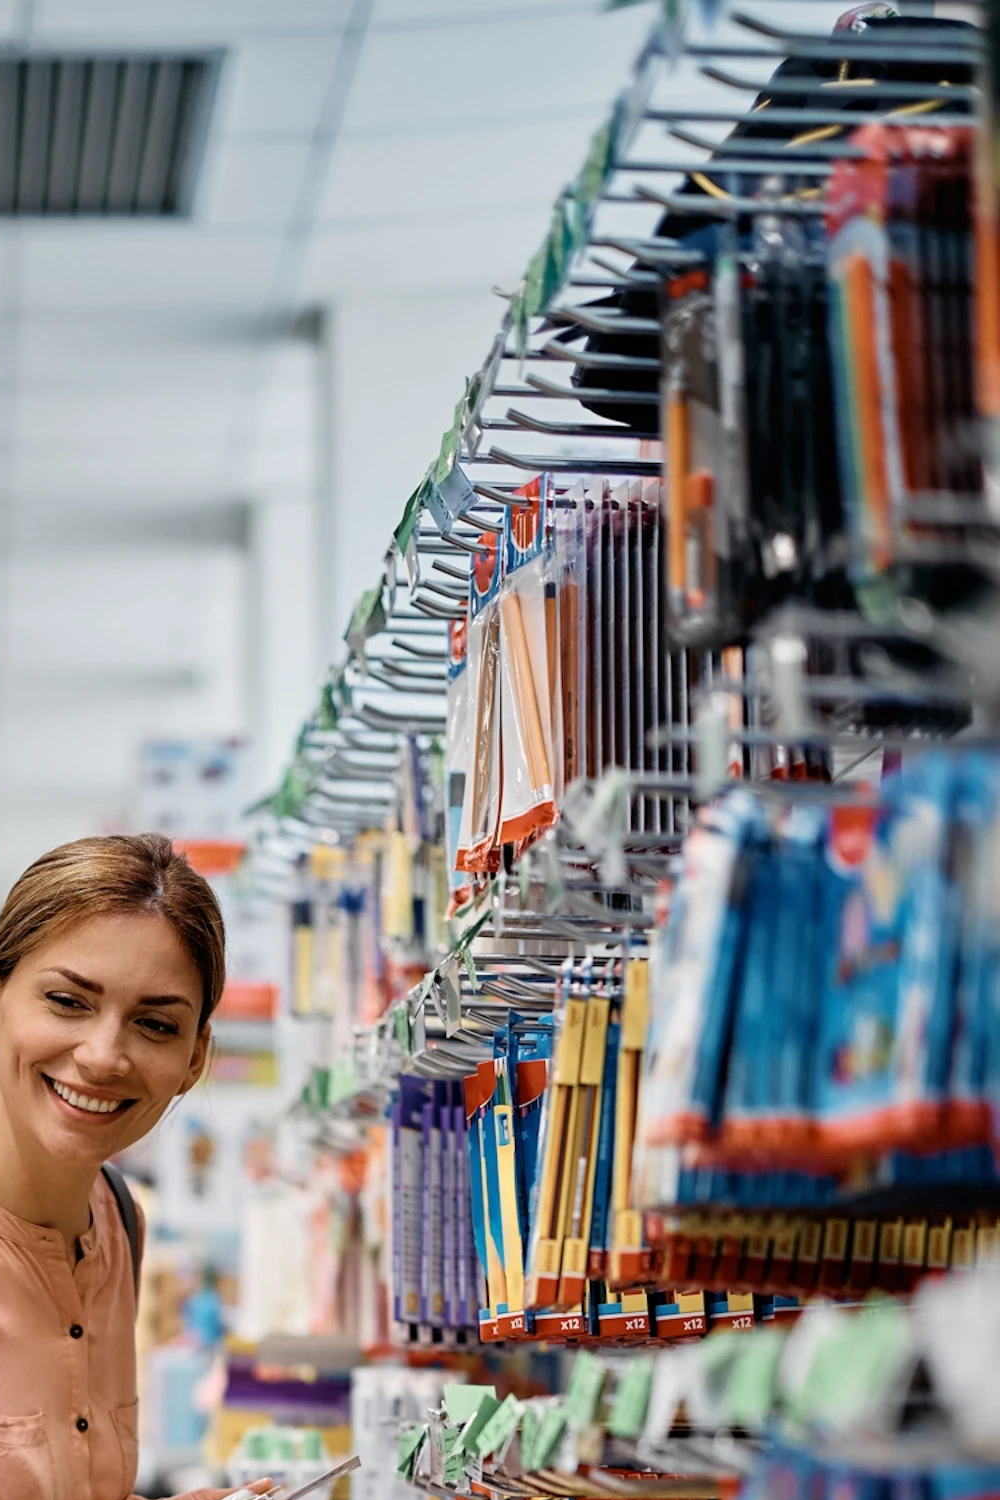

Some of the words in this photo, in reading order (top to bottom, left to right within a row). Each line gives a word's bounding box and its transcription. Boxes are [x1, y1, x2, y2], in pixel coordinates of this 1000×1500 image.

[510, 1317, 524, 1329] x12
[560, 1318, 580, 1331] x12
[625, 1318, 646, 1330] x12
[683, 1318, 704, 1330] x12
[732, 1317, 752, 1329] x12
